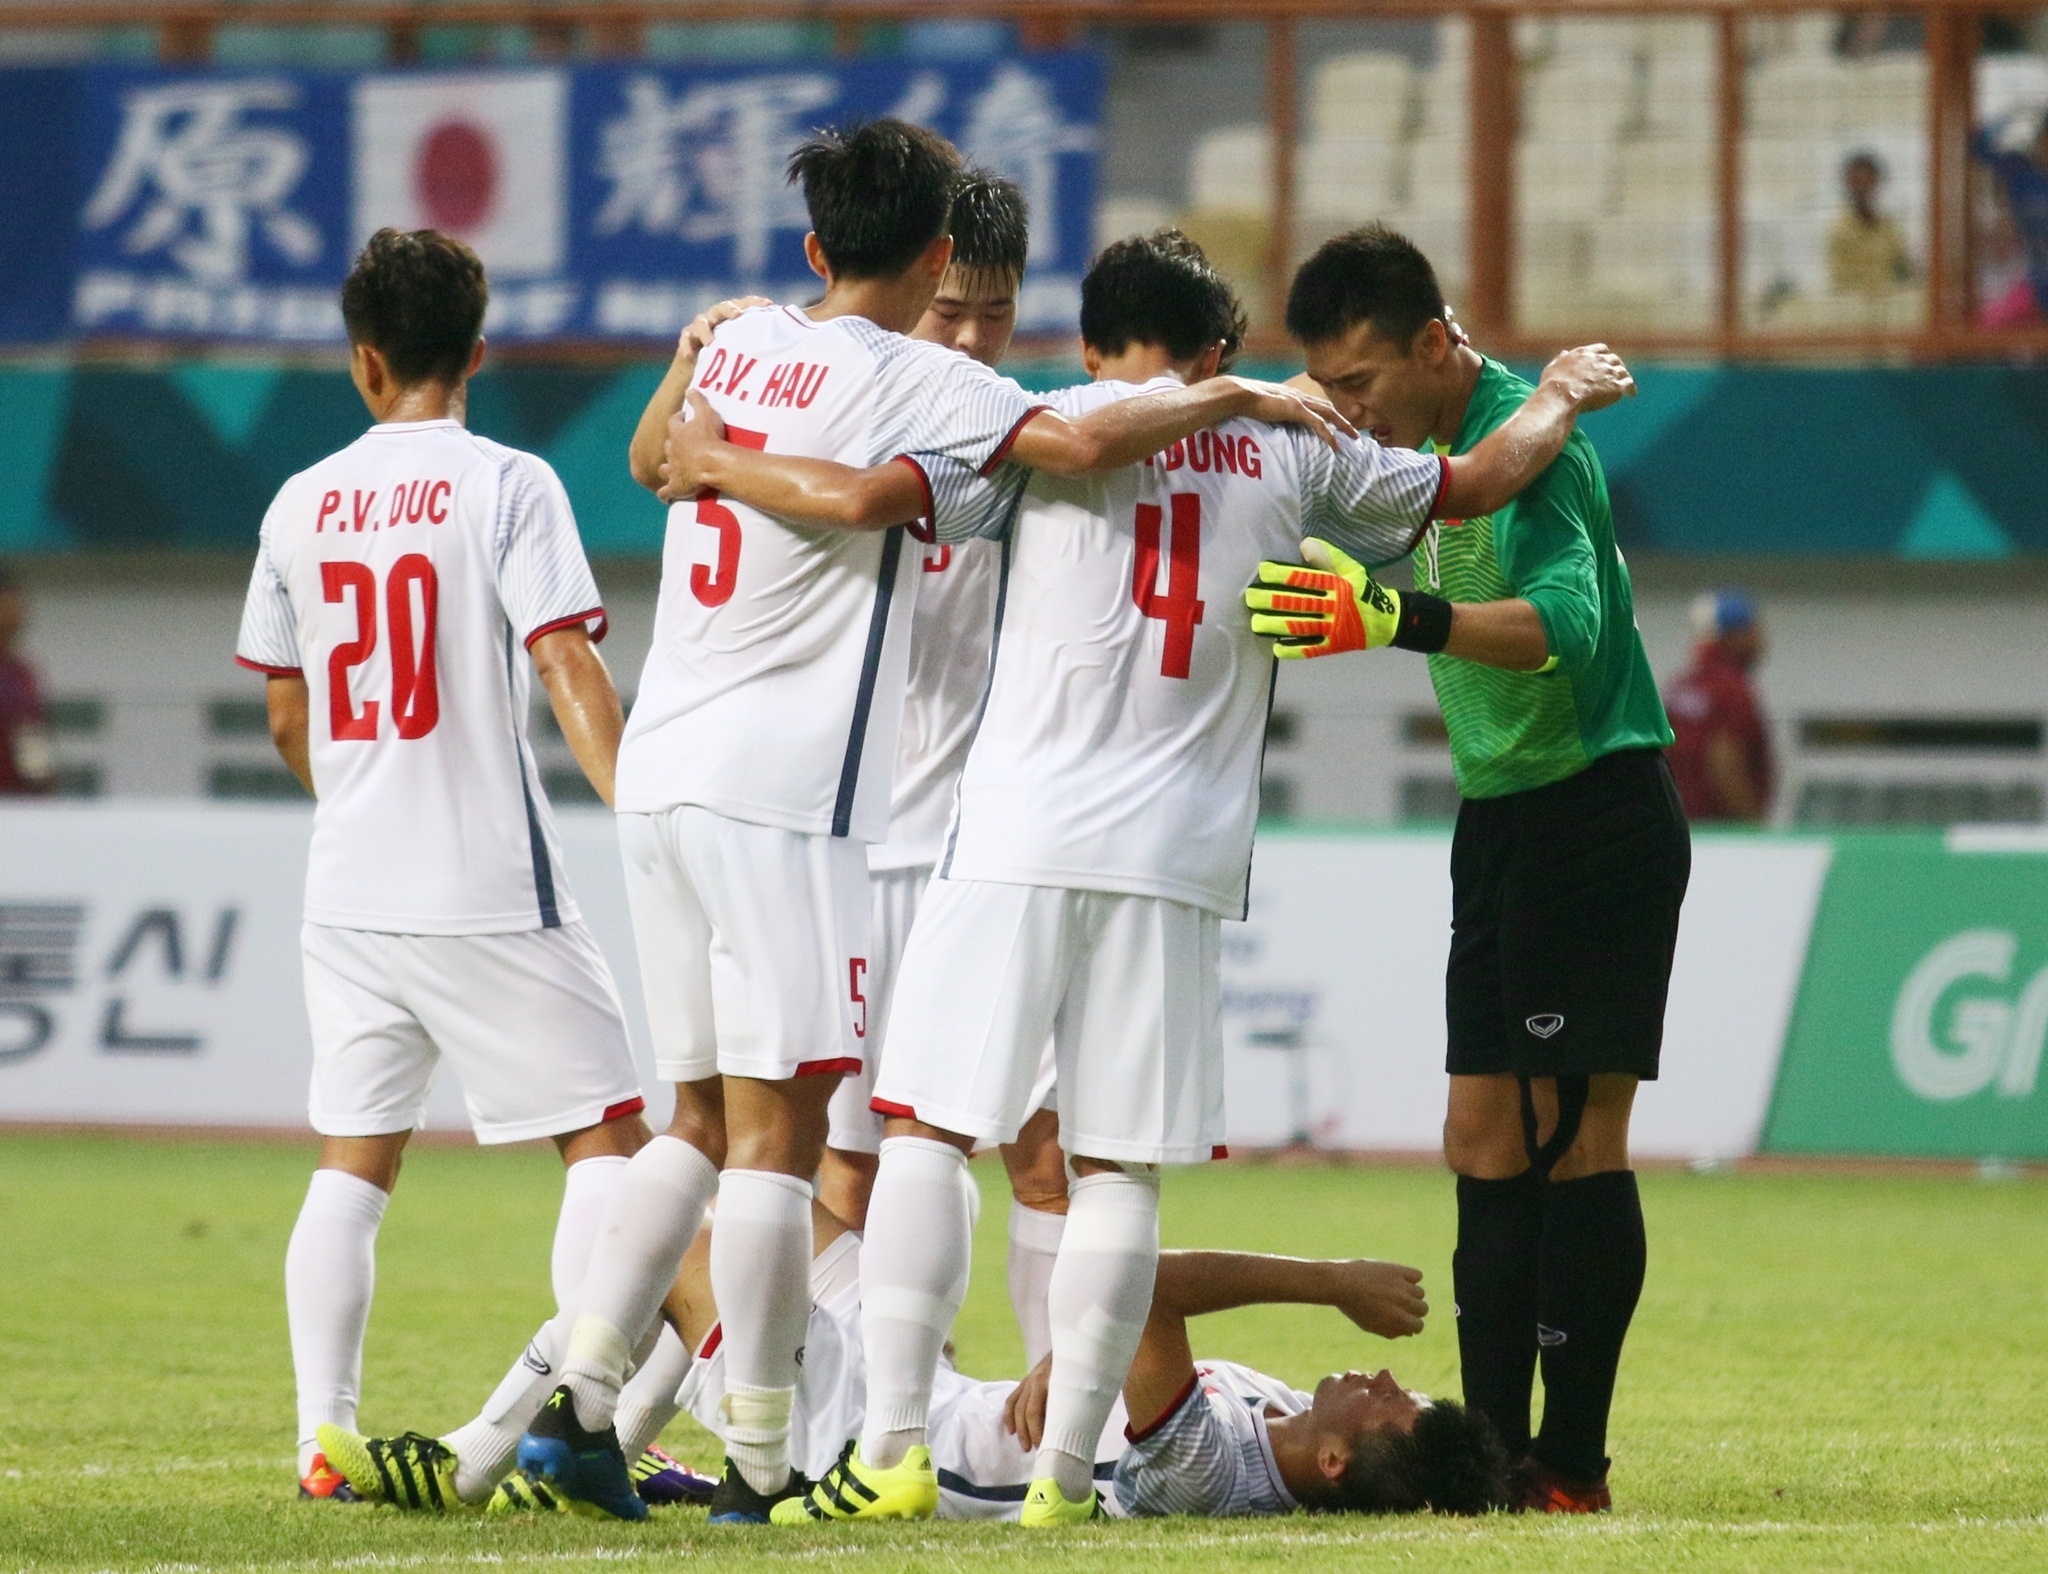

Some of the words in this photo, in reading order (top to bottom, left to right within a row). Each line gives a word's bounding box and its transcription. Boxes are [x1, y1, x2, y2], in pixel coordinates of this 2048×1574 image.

[698, 347, 757, 402] D.V.
[757, 361, 830, 409] HAU
[315, 489, 379, 534] P.V.
[388, 480, 452, 528] DUC
[1132, 492, 1205, 680] 4
[319, 552, 440, 742] 20
[849, 957, 867, 1038] 5
